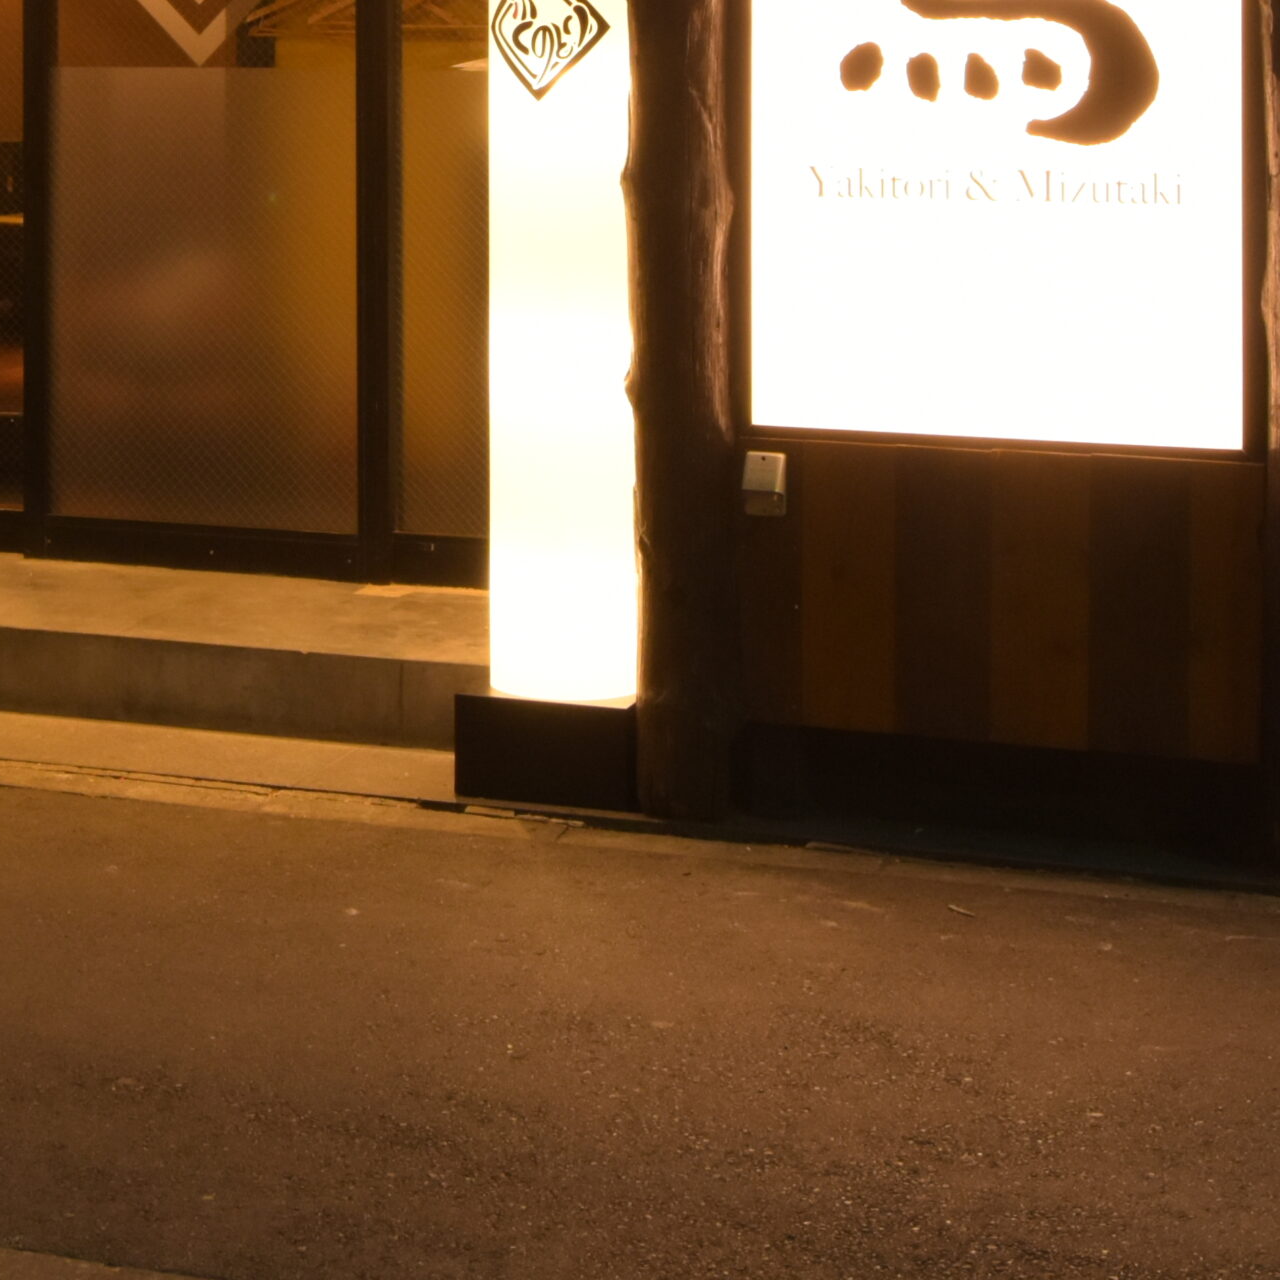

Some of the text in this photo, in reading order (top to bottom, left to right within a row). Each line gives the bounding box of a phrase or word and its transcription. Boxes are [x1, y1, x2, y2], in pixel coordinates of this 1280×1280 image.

[809, 166, 1182, 204] Yakitori & Mizutaki
